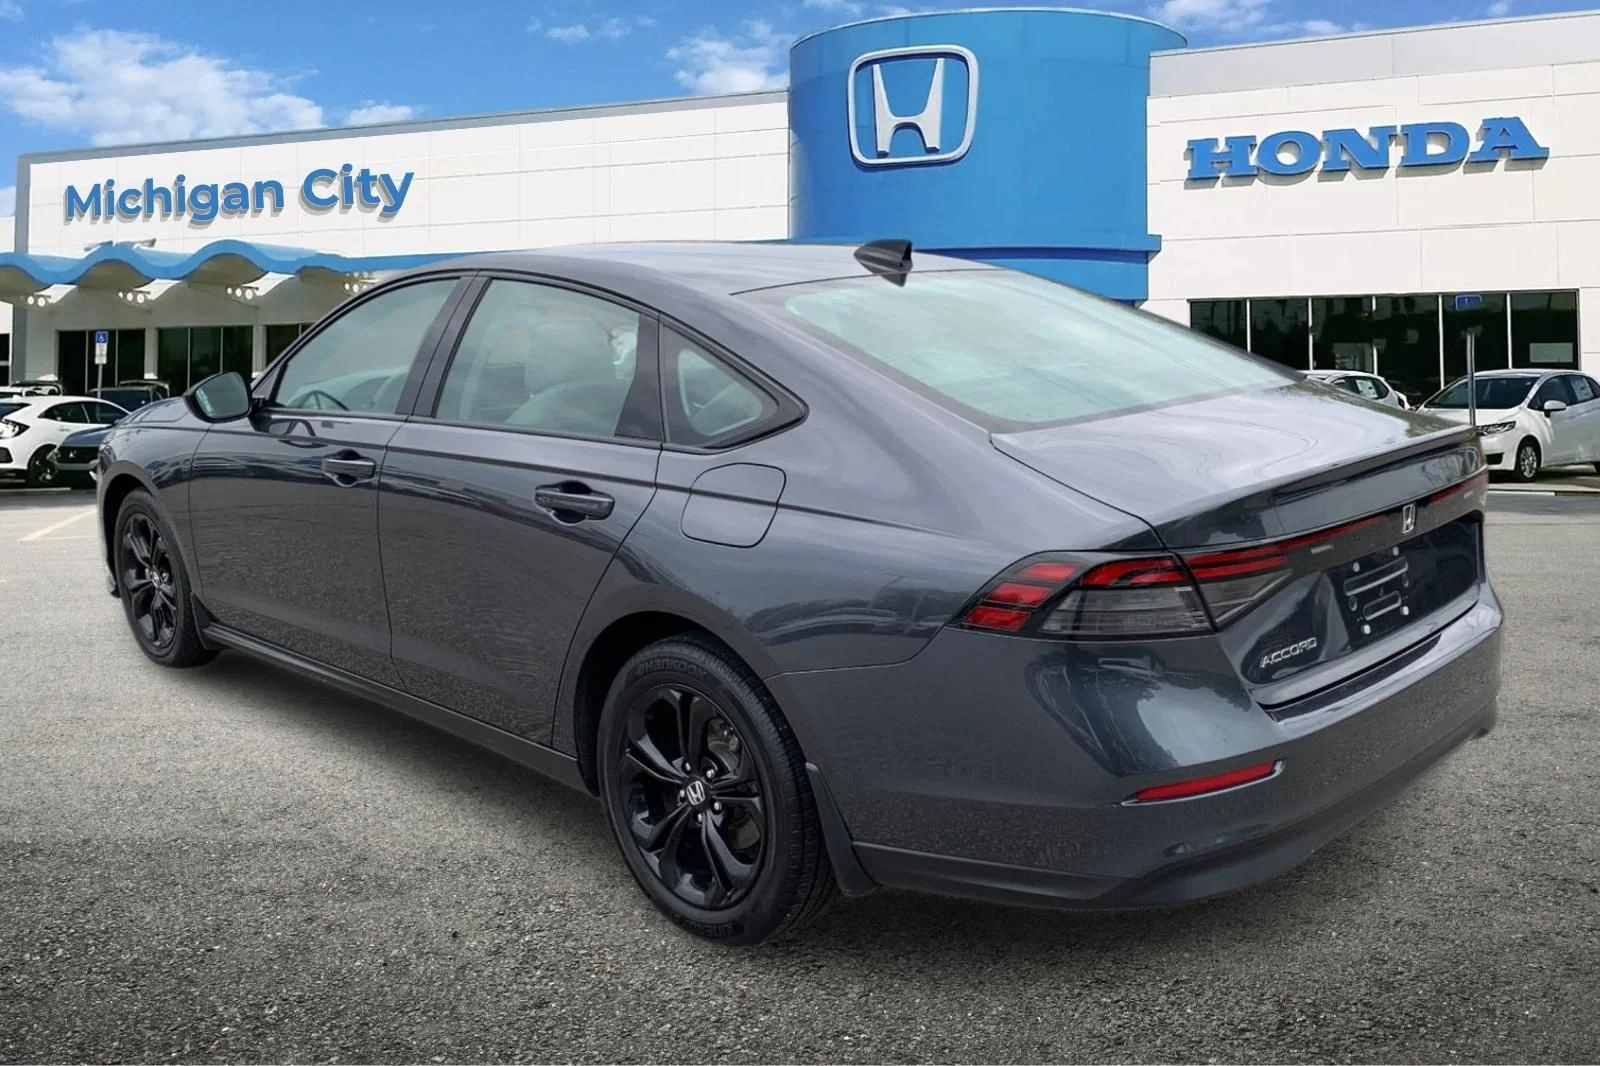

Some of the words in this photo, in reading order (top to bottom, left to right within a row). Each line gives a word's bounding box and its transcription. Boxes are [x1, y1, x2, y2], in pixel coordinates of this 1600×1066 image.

[1186, 116, 1550, 181] HONDA
[65, 175, 284, 222] Michigan
[301, 163, 415, 214] City
[1260, 637, 1317, 668] ACCORD
